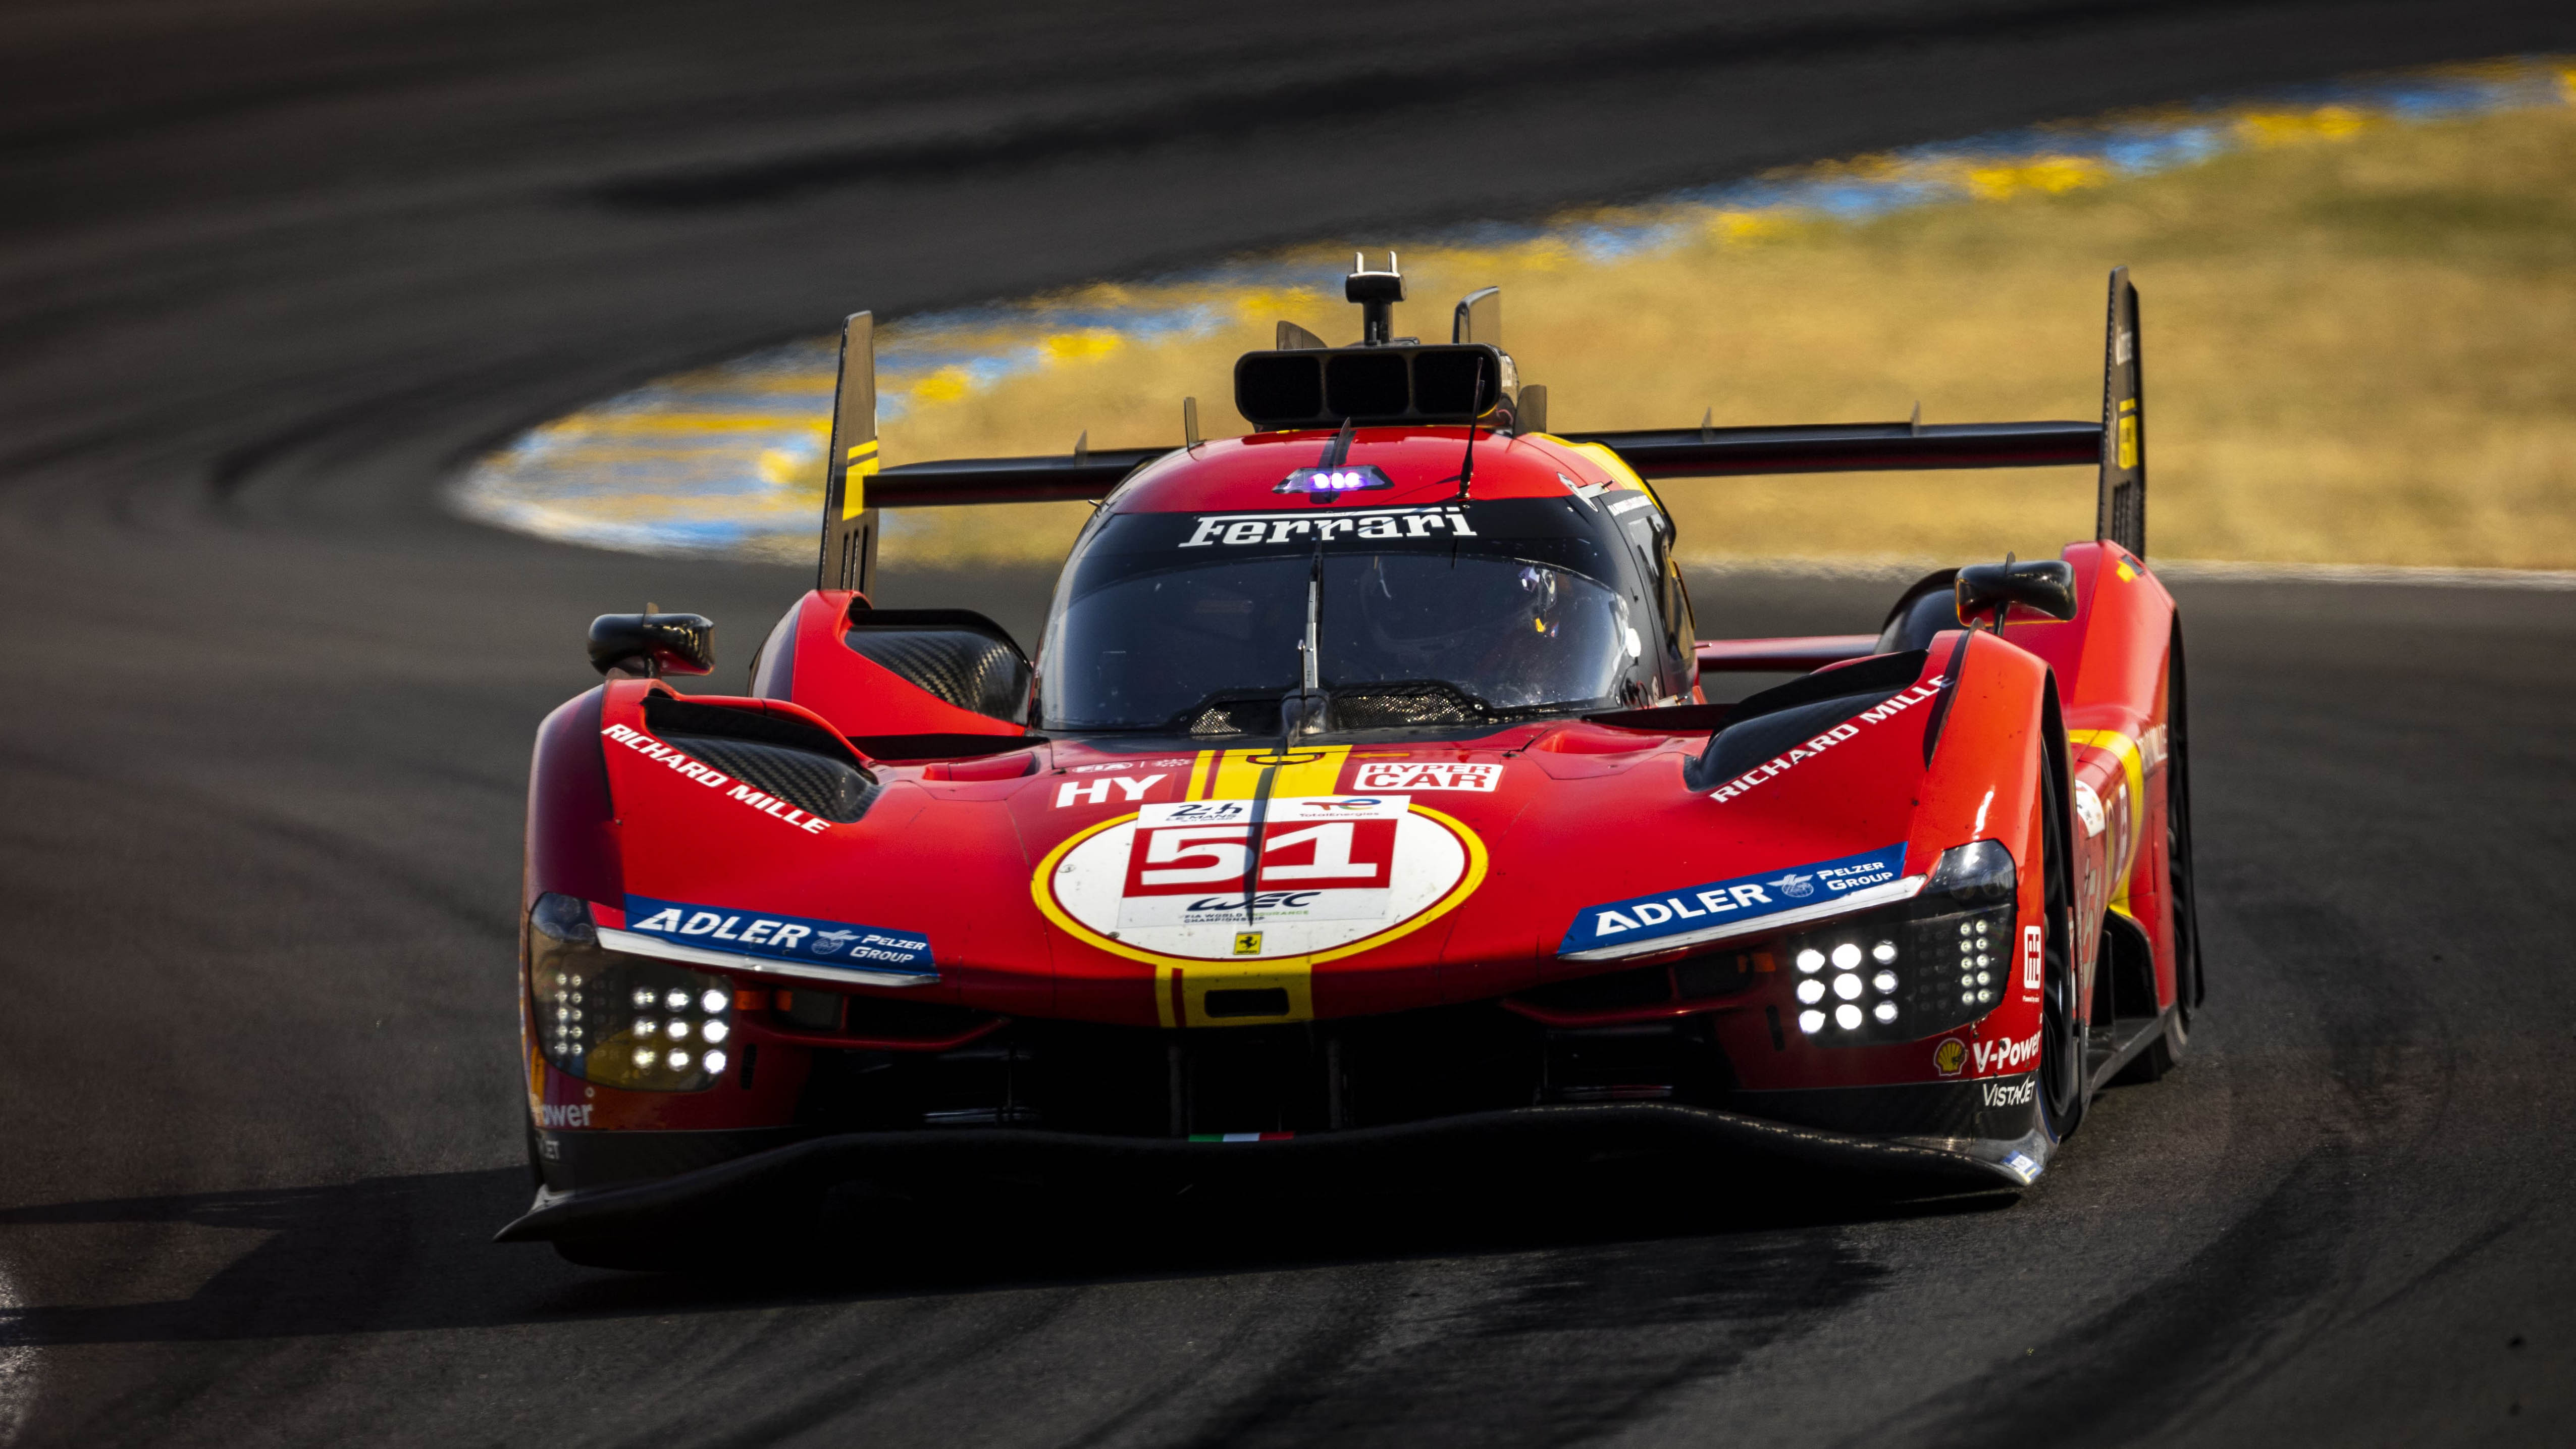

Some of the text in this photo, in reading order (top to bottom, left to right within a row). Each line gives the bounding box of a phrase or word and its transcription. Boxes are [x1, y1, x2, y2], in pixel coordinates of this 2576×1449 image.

[1178, 506, 1478, 548] Ferrari
[1709, 675, 1956, 803] RICHARD MILLE
[601, 723, 831, 834] RICHARD MILLE
[1364, 773, 1487, 788] CAR
[1368, 765, 1492, 774] HYPER
[1056, 774, 1168, 808] HY
[1141, 822, 1378, 886] 51
[1186, 892, 1322, 911] WEC
[1595, 861, 1885, 937] ADLER PELZER
[1826, 871, 1895, 891] GROUP
[632, 908, 926, 951] ADLER PELZER
[850, 947, 915, 963] GROUP
[1972, 1029, 2041, 1074] V-Power
